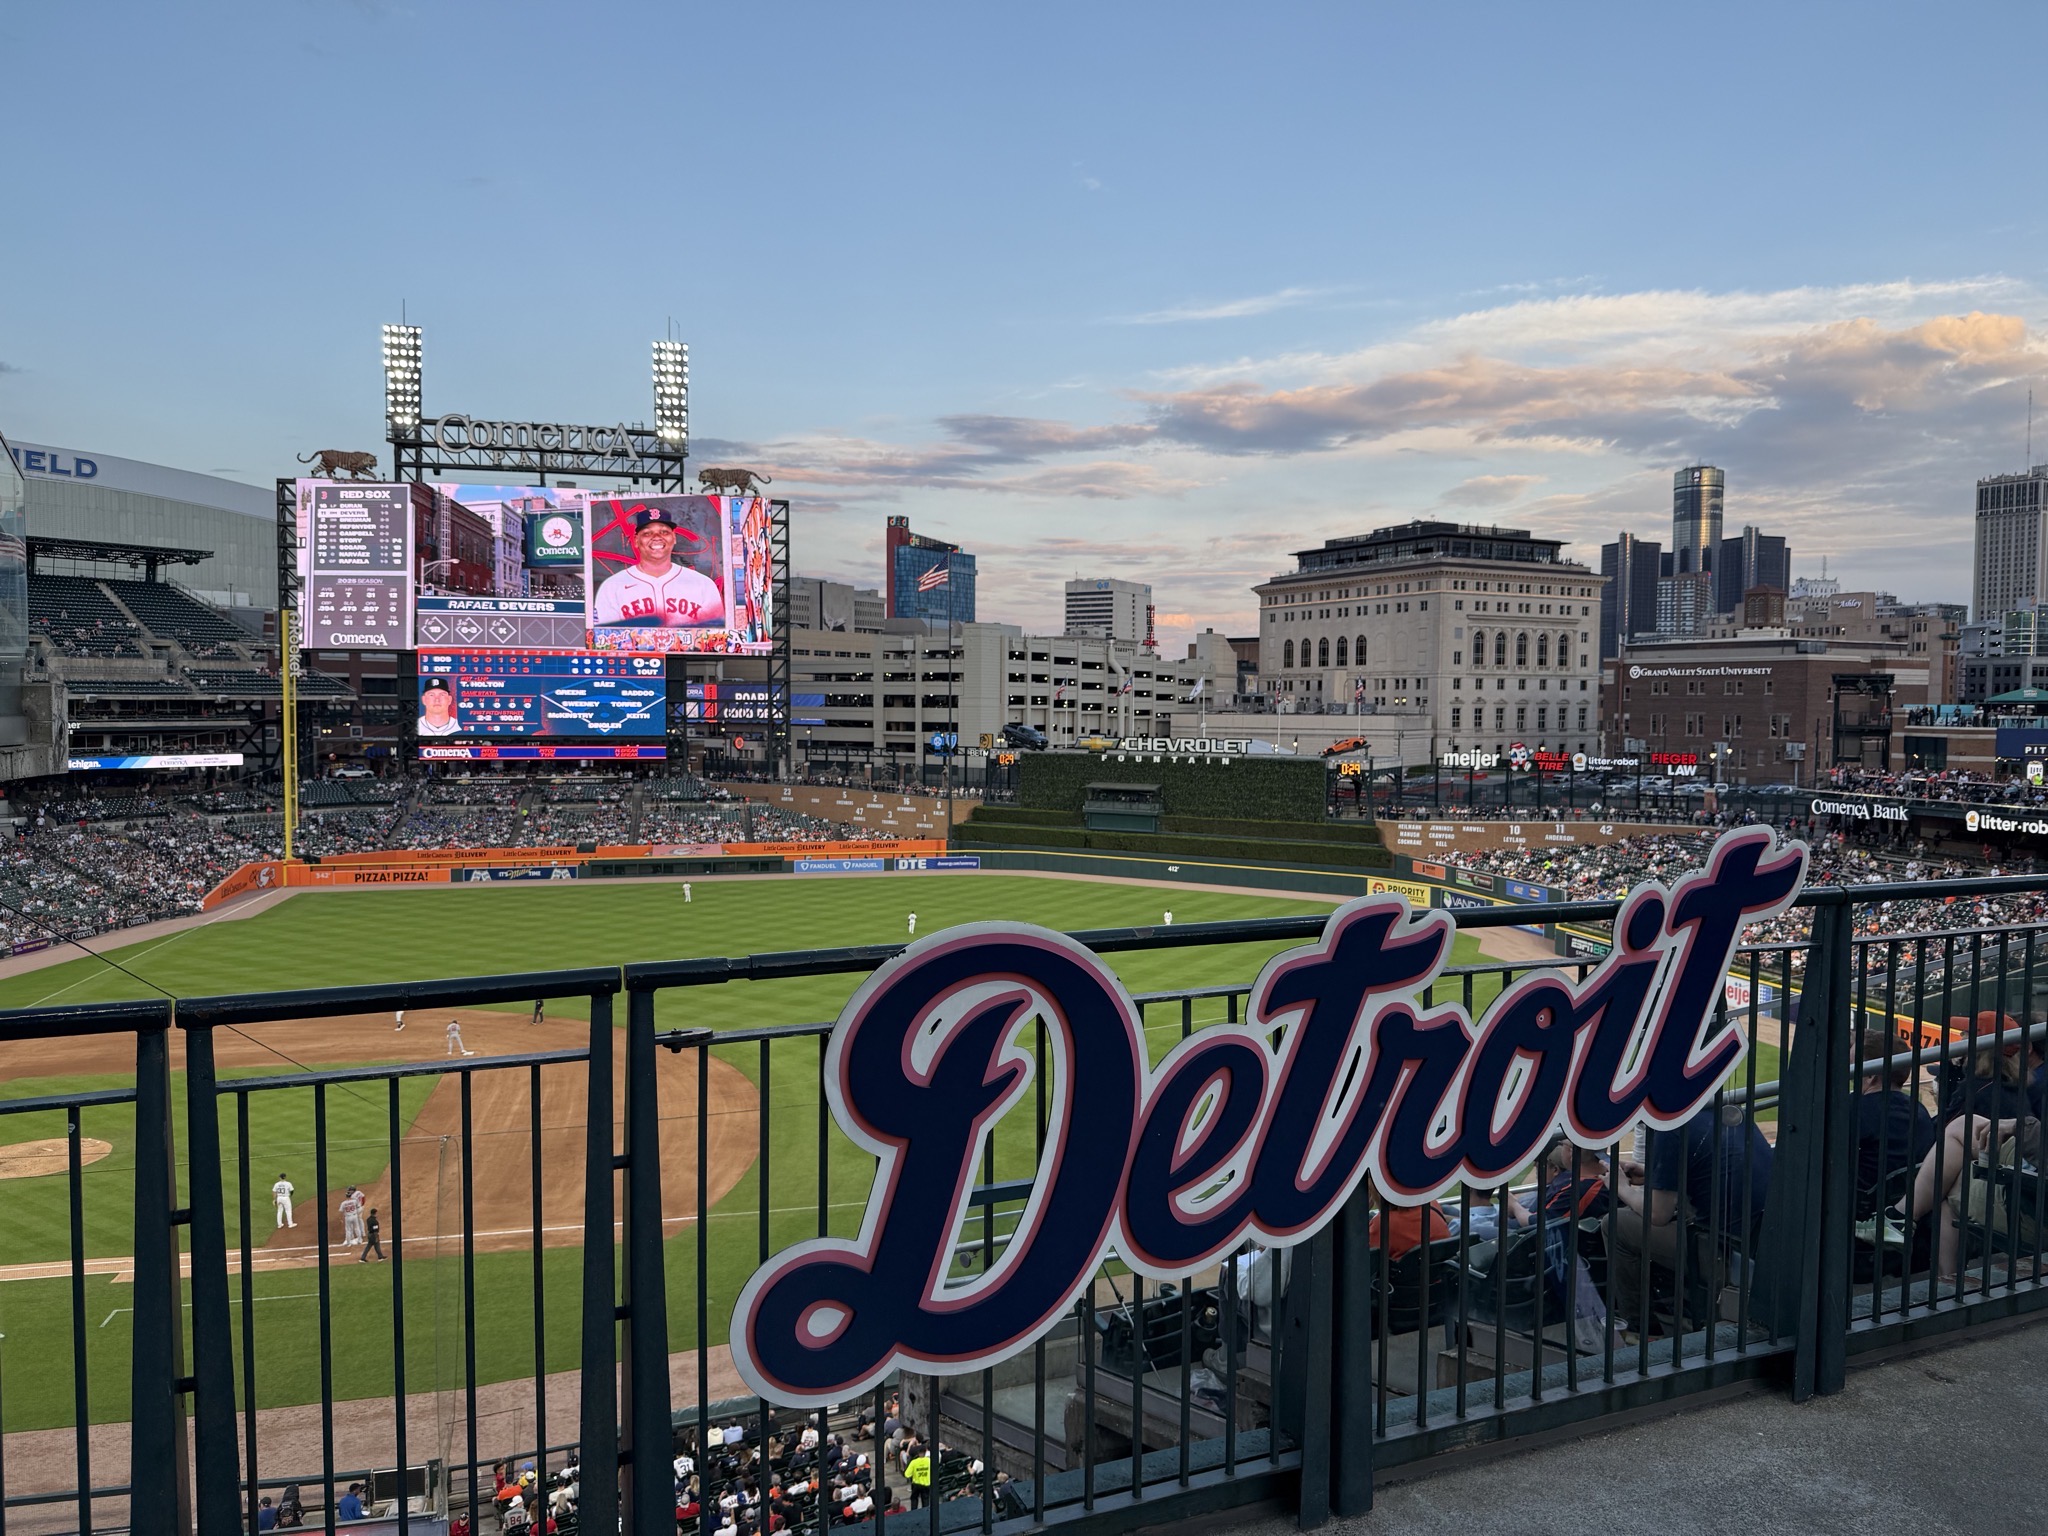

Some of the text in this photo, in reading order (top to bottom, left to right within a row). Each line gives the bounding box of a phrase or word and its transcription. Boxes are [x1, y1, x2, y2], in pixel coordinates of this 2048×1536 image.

[11, 448, 98, 479] ELD
[493, 451, 587, 469] PARK
[340, 490, 391, 499] RED SOX
[448, 600, 555, 611] RAFAEL DEVERS
[621, 597, 702, 620] RED SOX
[633, 658, 661, 668] 0-0
[1641, 666, 1772, 677] GRAND VALLEY STATE UNIVERSITY
[1124, 737, 1253, 754] CHEVROLET
[1101, 754, 1230, 765] FOUNTAIN
[1443, 749, 1500, 770] meijer
[1534, 752, 1569, 762] BELLE
[1651, 753, 1697, 765] FIEGER
[68, 760, 101, 769] ichigan.
[1341, 763, 1361, 775] 0:29
[1537, 762, 1565, 771] TIRE
[1667, 765, 1697, 776] LAW
[1873, 803, 1909, 821] Bank
[1509, 825, 1521, 835] 10
[1555, 824, 1565, 833] 11
[1599, 825, 1613, 835] 42
[1503, 836, 1526, 844] LEYLAND
[1544, 834, 1575, 842] ANDERSON
[851, 861, 878, 869] FANDUEL
[898, 858, 927, 870] DTE
[354, 871, 429, 883] PIZZA! PIZZA!
[1387, 884, 1426, 897] PRIORITY
[729, 825, 1810, 1410] Detroit
[680, 1463, 690, 1475] 31
